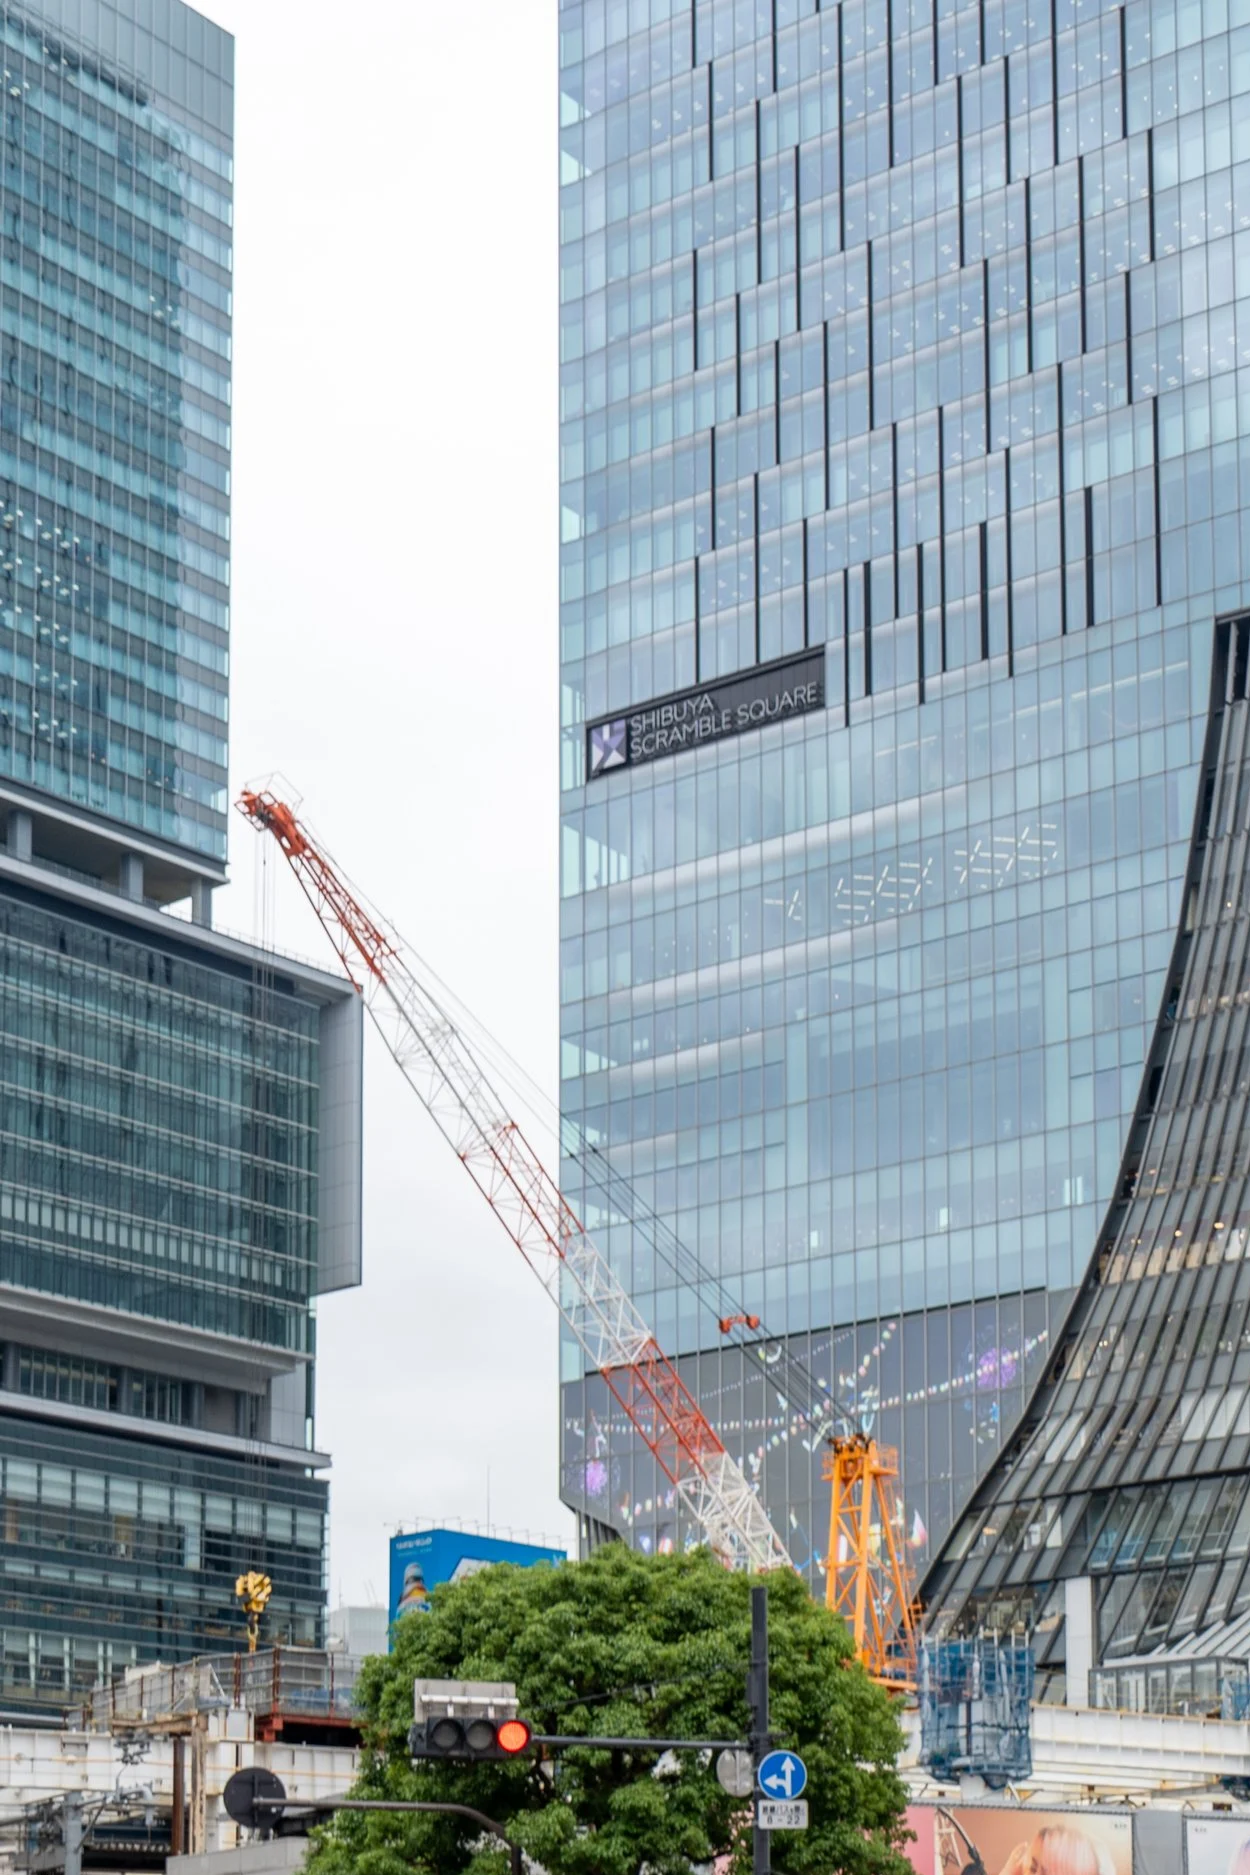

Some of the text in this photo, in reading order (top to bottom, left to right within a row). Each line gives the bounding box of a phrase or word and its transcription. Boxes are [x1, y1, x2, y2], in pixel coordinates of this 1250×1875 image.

[630, 693, 715, 737] SHIBUYA
[630, 681, 819, 760] SCRAMBLE SQUARE
